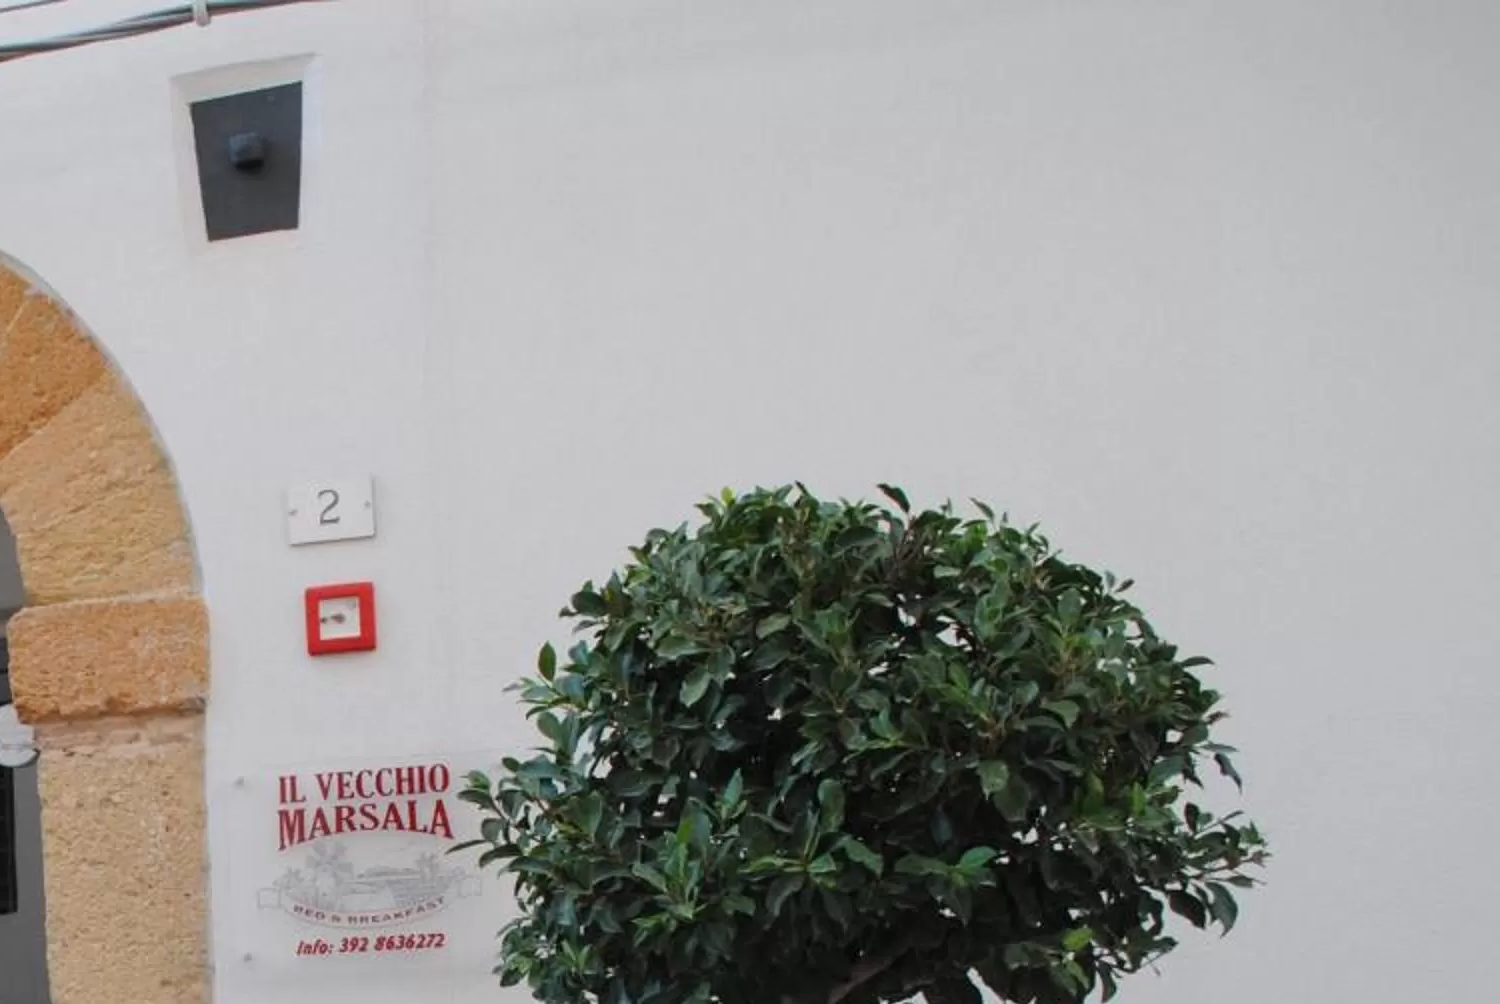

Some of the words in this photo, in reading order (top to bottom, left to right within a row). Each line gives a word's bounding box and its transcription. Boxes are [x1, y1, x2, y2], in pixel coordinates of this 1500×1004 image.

[317, 489, 340, 525] 2
[279, 776, 306, 804] IL
[316, 763, 449, 800] VECCHIO
[277, 799, 454, 851] MARSALA
[348, 896, 445, 924] BREAKFAST
[296, 939, 333, 956] Info:
[339, 937, 369, 953] 392
[374, 933, 446, 951] 8636272
